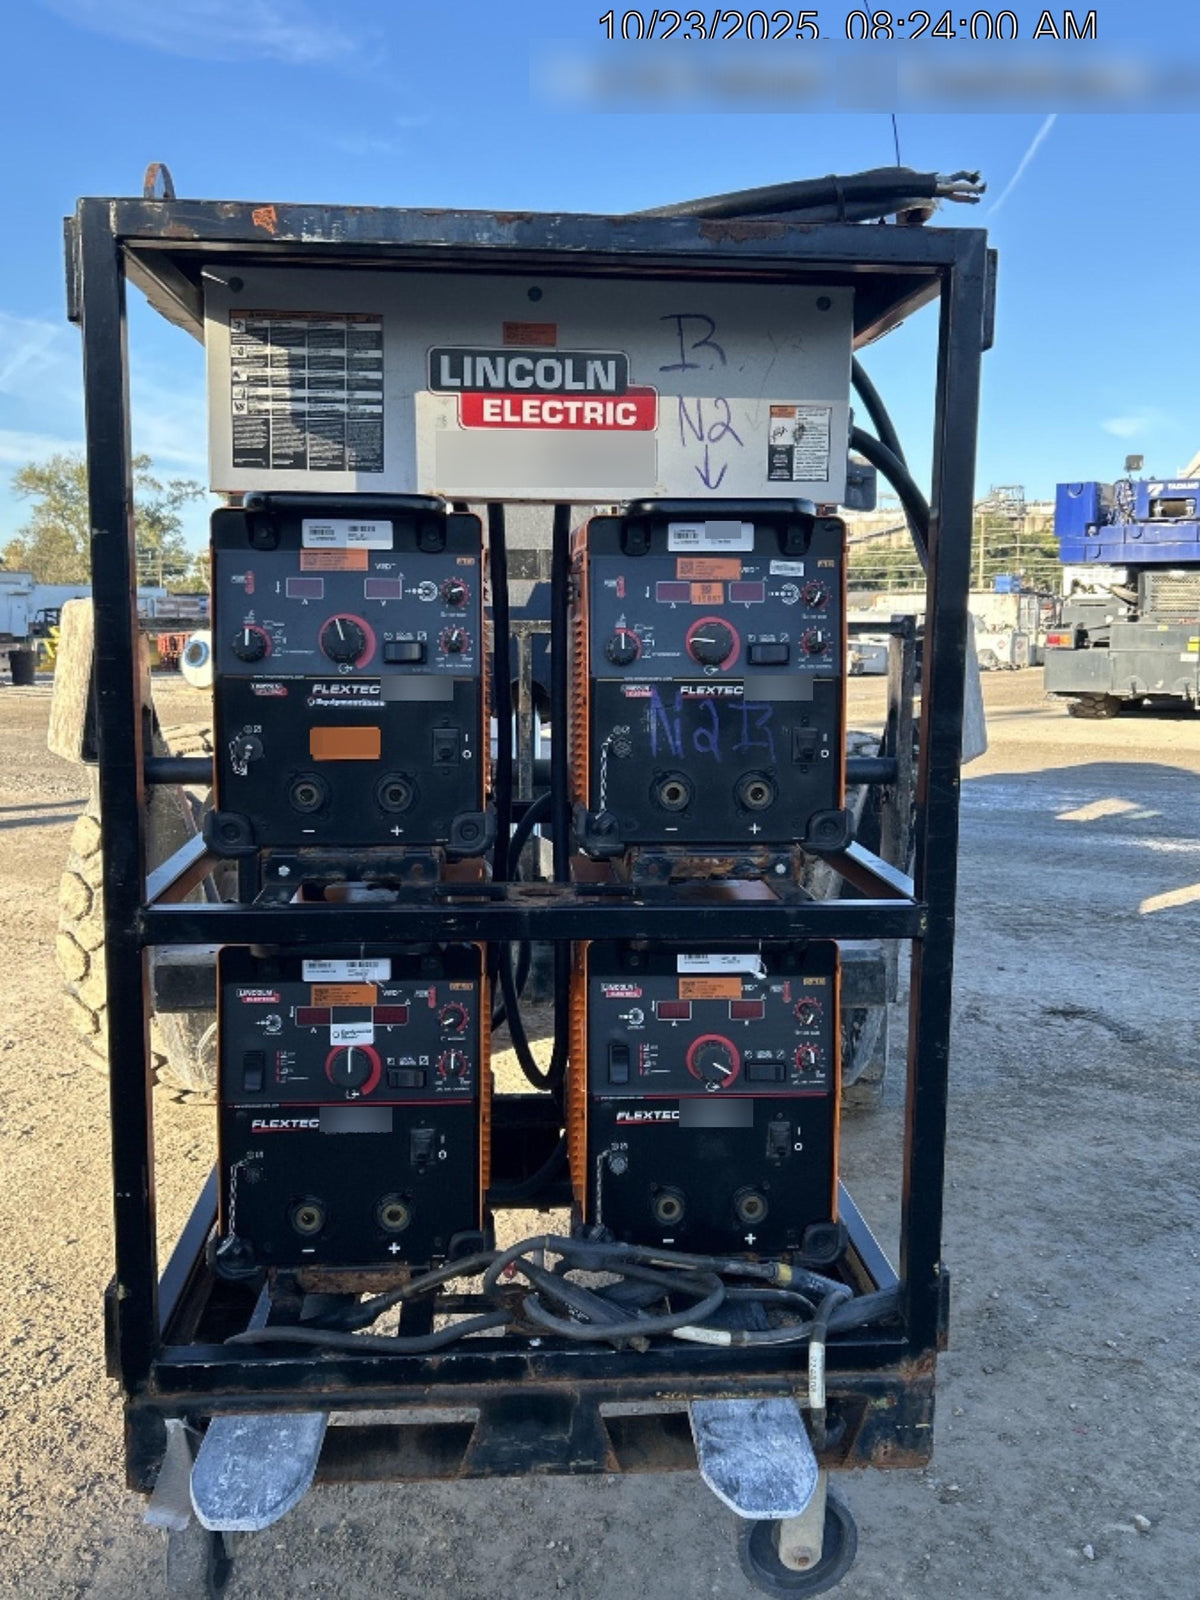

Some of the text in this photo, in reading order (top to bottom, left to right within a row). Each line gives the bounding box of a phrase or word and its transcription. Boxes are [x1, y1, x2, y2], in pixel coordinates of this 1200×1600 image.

[440, 355, 616, 391] LINCOLN
[482, 398, 637, 426] ELECTRIC
[312, 684, 381, 694] FLEXTEC
[680, 686, 744, 695] FLEXTEC
[615, 1110, 680, 1120] FLEXTEC
[252, 1119, 320, 1128] FLEXTEC
